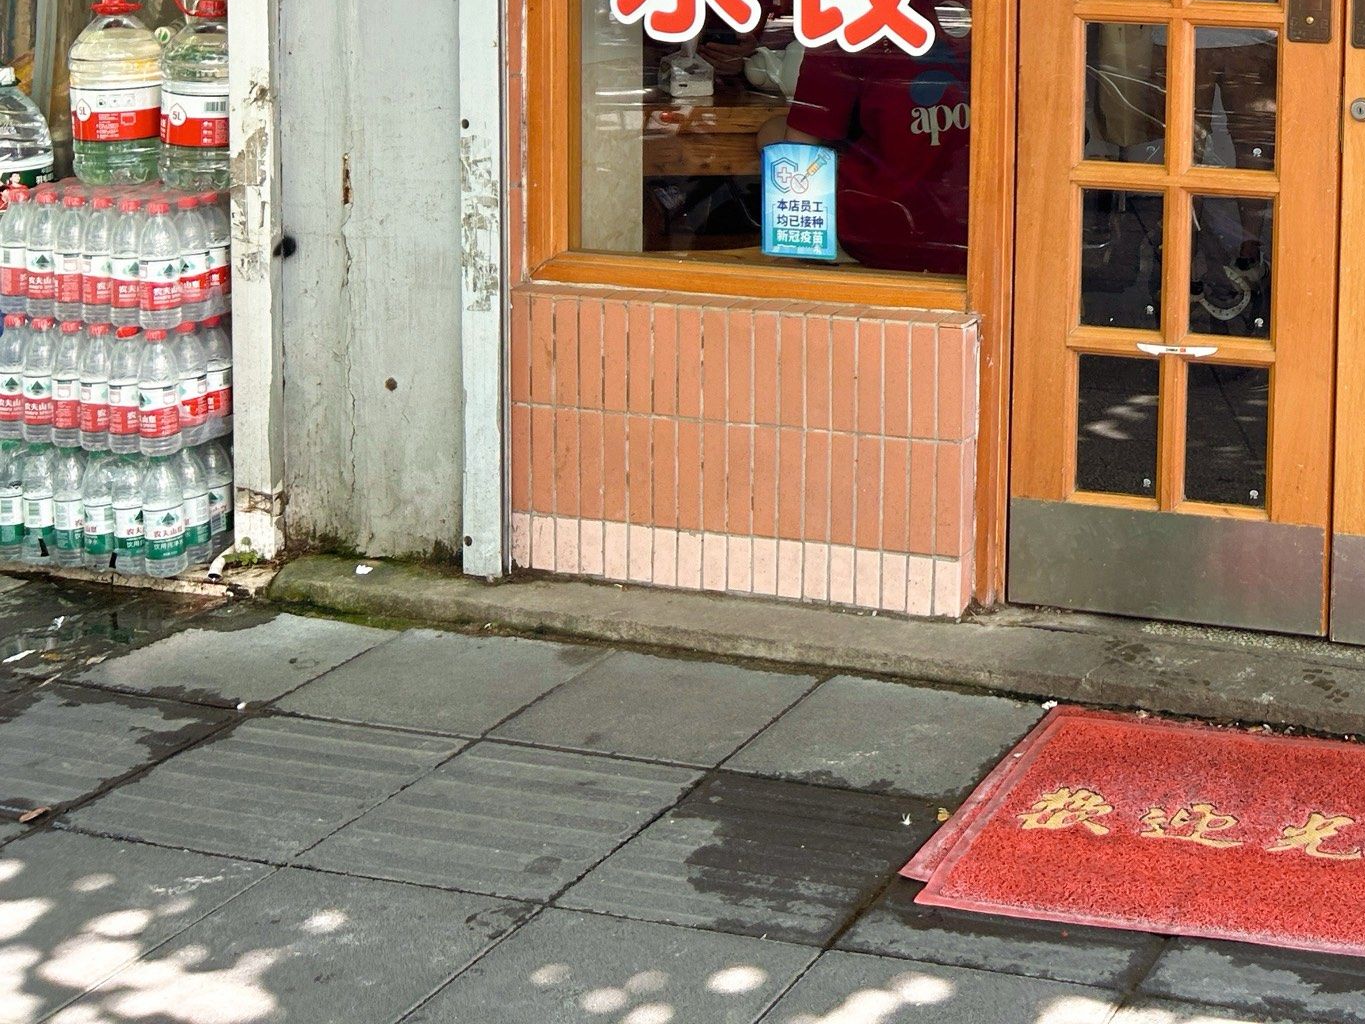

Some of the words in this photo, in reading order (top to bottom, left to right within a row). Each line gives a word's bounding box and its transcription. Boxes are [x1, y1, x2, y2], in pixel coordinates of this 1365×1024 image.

[172, 112, 182, 121] 5L
[910, 102, 970, 146] apo
[777, 199, 823, 213] 本店员工
[777, 214, 824, 228] 均已接种
[777, 230, 823, 246] 新冠疫苗
